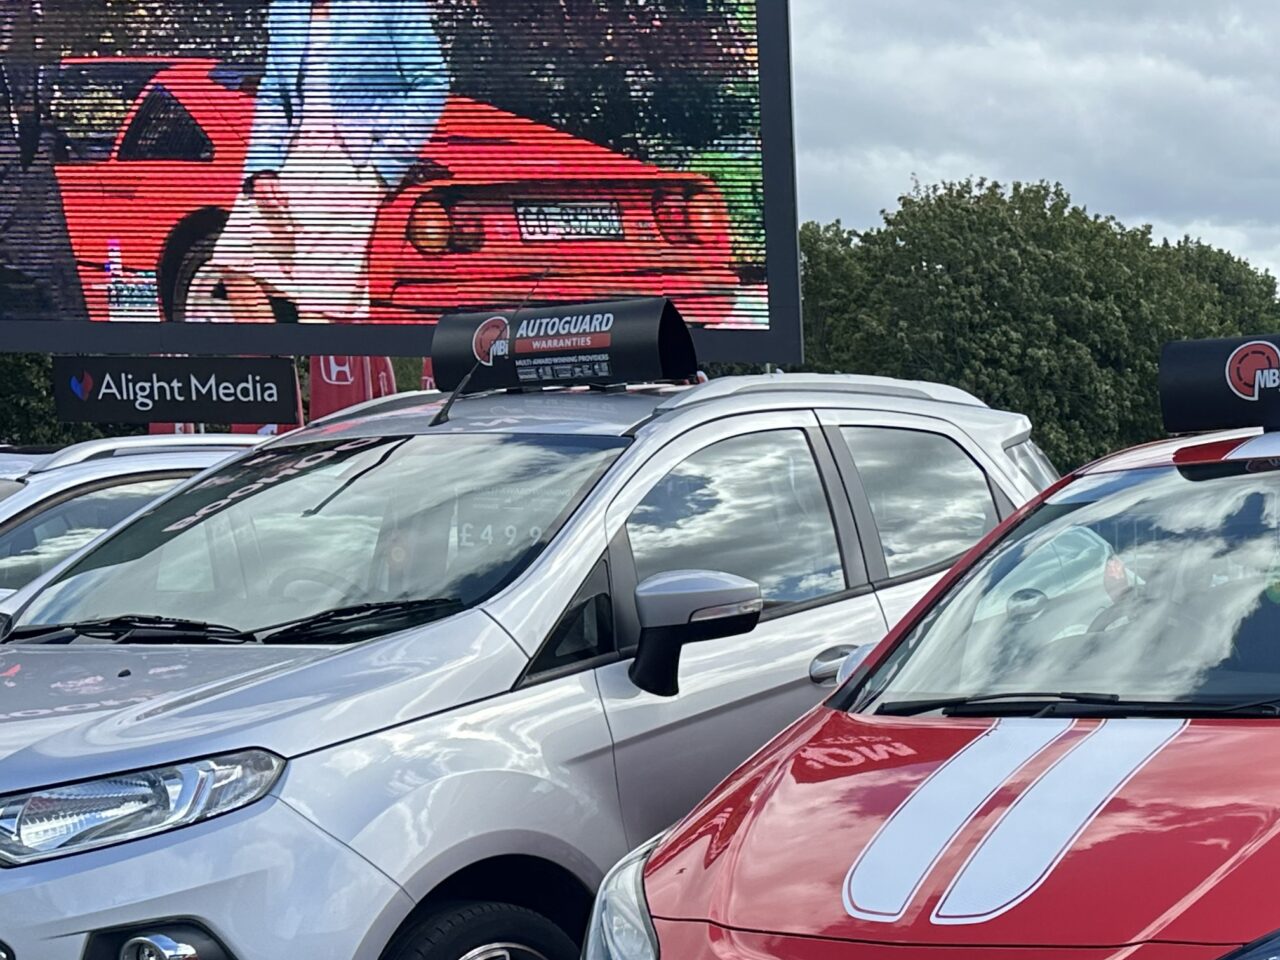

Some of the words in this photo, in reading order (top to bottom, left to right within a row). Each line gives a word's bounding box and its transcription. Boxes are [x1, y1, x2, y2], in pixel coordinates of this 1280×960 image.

[516, 313, 614, 338] AUTOGUARD
[532, 336, 592, 350] WARRANTIES
[98, 371, 184, 411] Alight
[190, 373, 278, 401] Media
